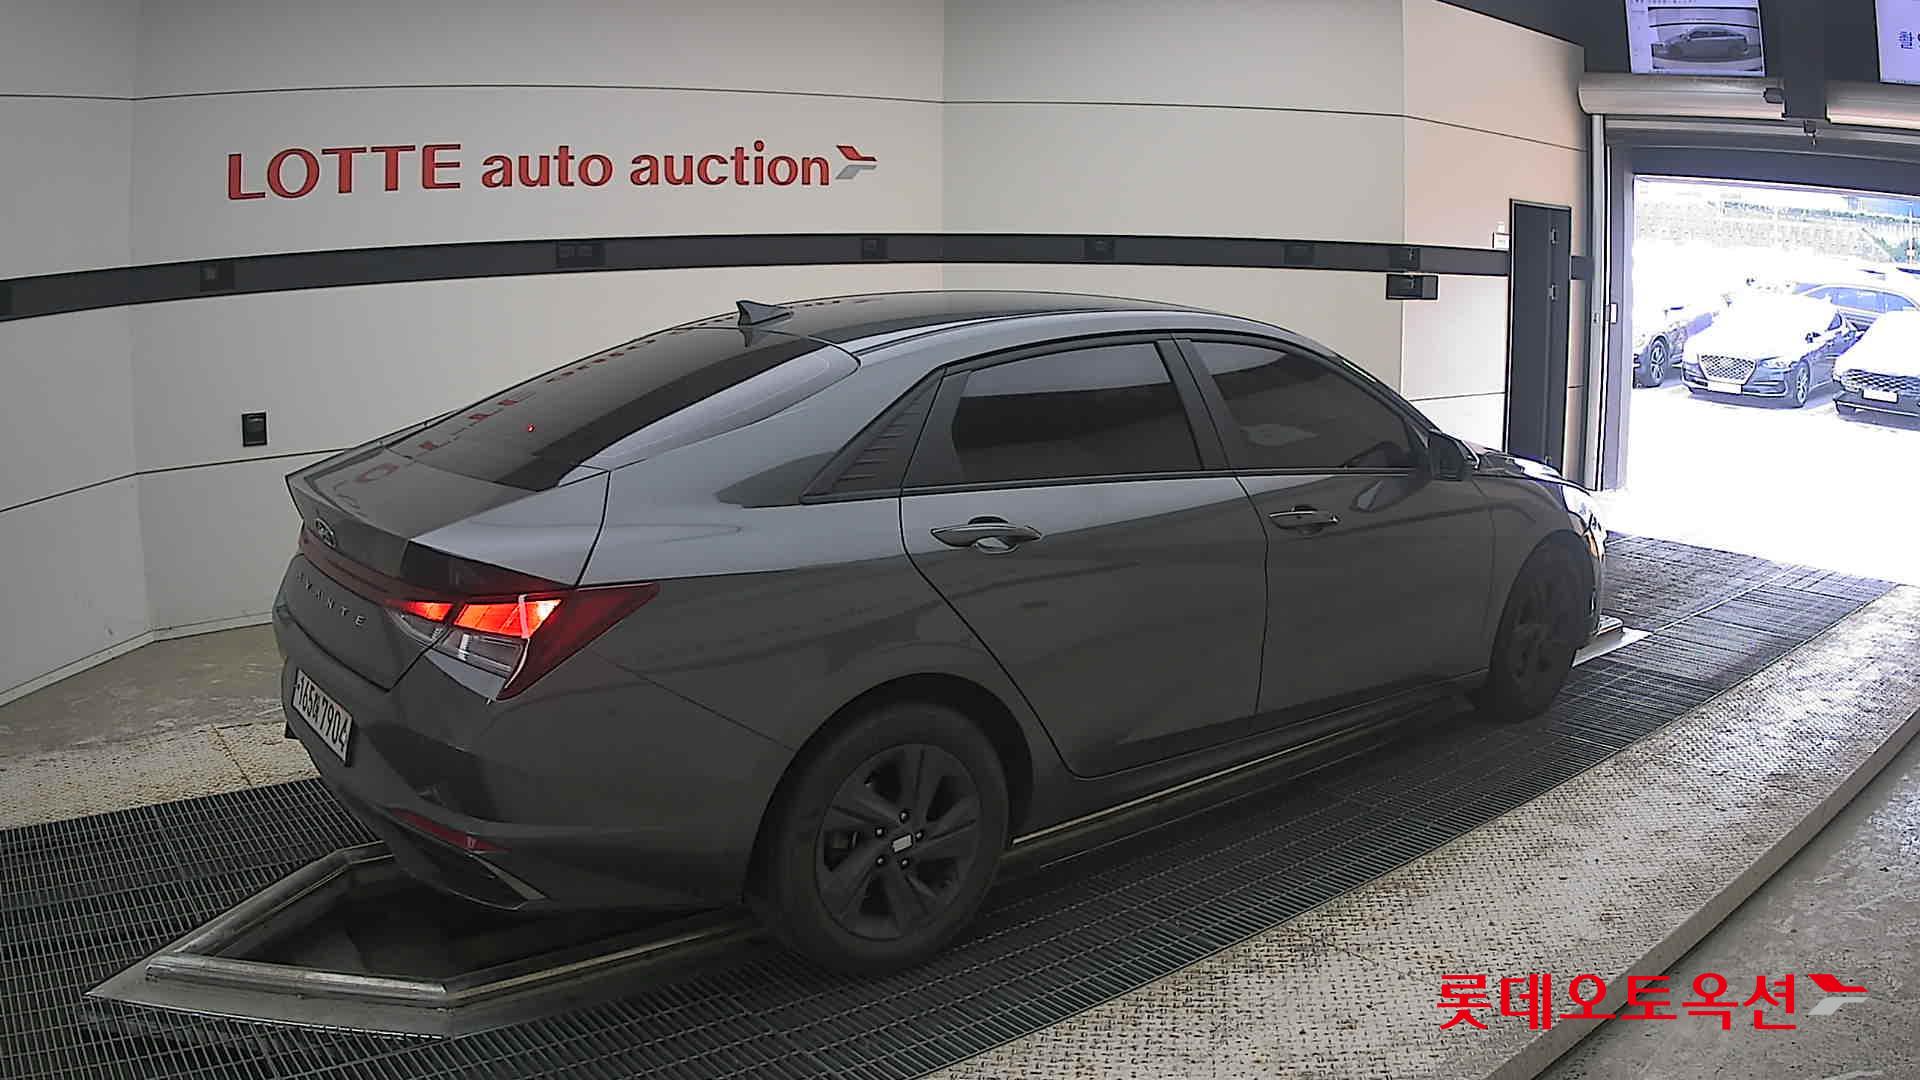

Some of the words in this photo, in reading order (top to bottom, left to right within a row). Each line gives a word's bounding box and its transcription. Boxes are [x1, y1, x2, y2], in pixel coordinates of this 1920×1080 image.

[228, 145, 462, 200] LOTTE
[481, 144, 614, 189] auto
[629, 140, 831, 187] auction
